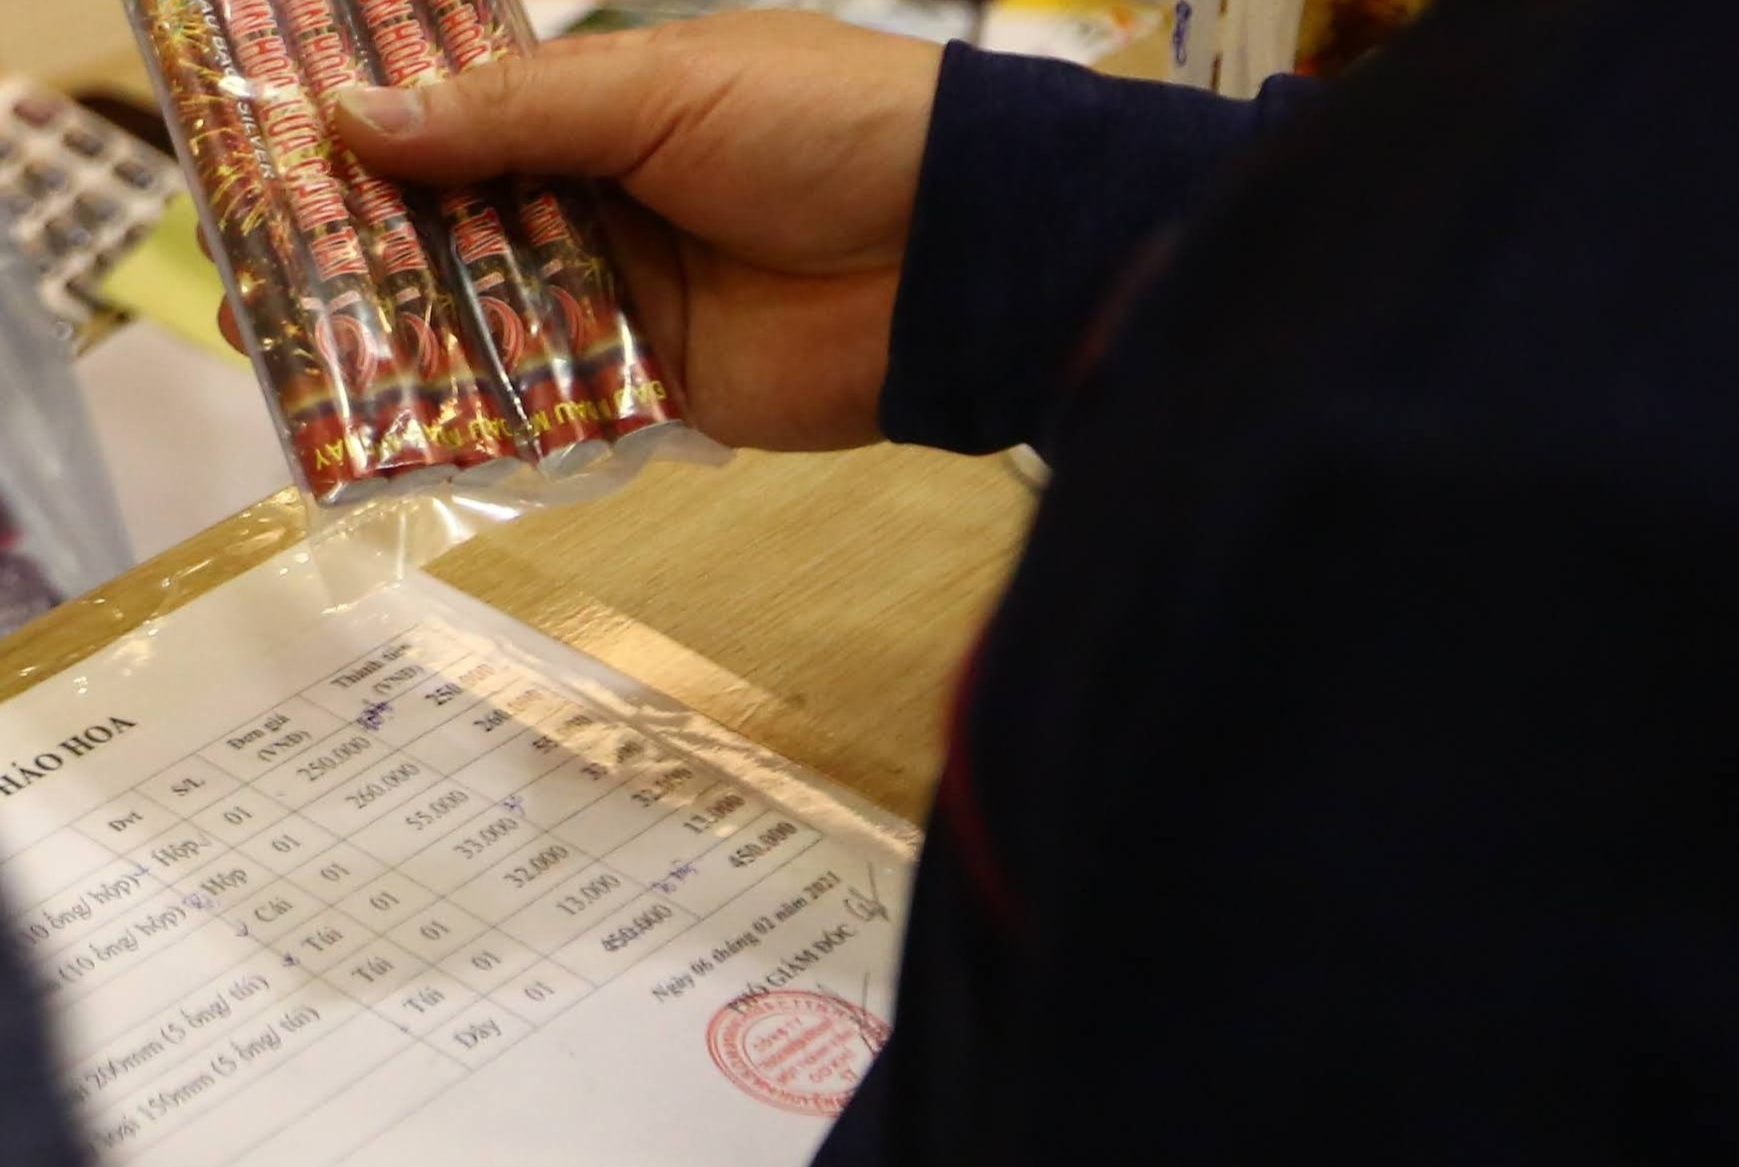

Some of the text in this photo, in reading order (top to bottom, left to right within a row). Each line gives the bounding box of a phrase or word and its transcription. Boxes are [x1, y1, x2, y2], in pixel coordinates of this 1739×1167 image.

[295, 31, 358, 95] HOA
[373, 18, 437, 89] HOA
[439, 3, 491, 75] HOA
[311, 224, 370, 283] TAY
[58, 716, 138, 757] HOA
[223, 806, 253, 826] 01
[296, 735, 371, 782] 250.000
[272, 834, 302, 854] 01
[345, 762, 421, 809] 260.000
[320, 863, 351, 882] 01
[405, 789, 470, 831] 55.000
[369, 891, 400, 911] 01
[452, 816, 520, 860] 33.000
[419, 920, 451, 941] 01
[503, 845, 569, 888] 32.000
[470, 949, 502, 971] 01
[556, 873, 622, 916] 13.000
[523, 980, 555, 1003] 01
[727, 820, 798, 869] 450.000
